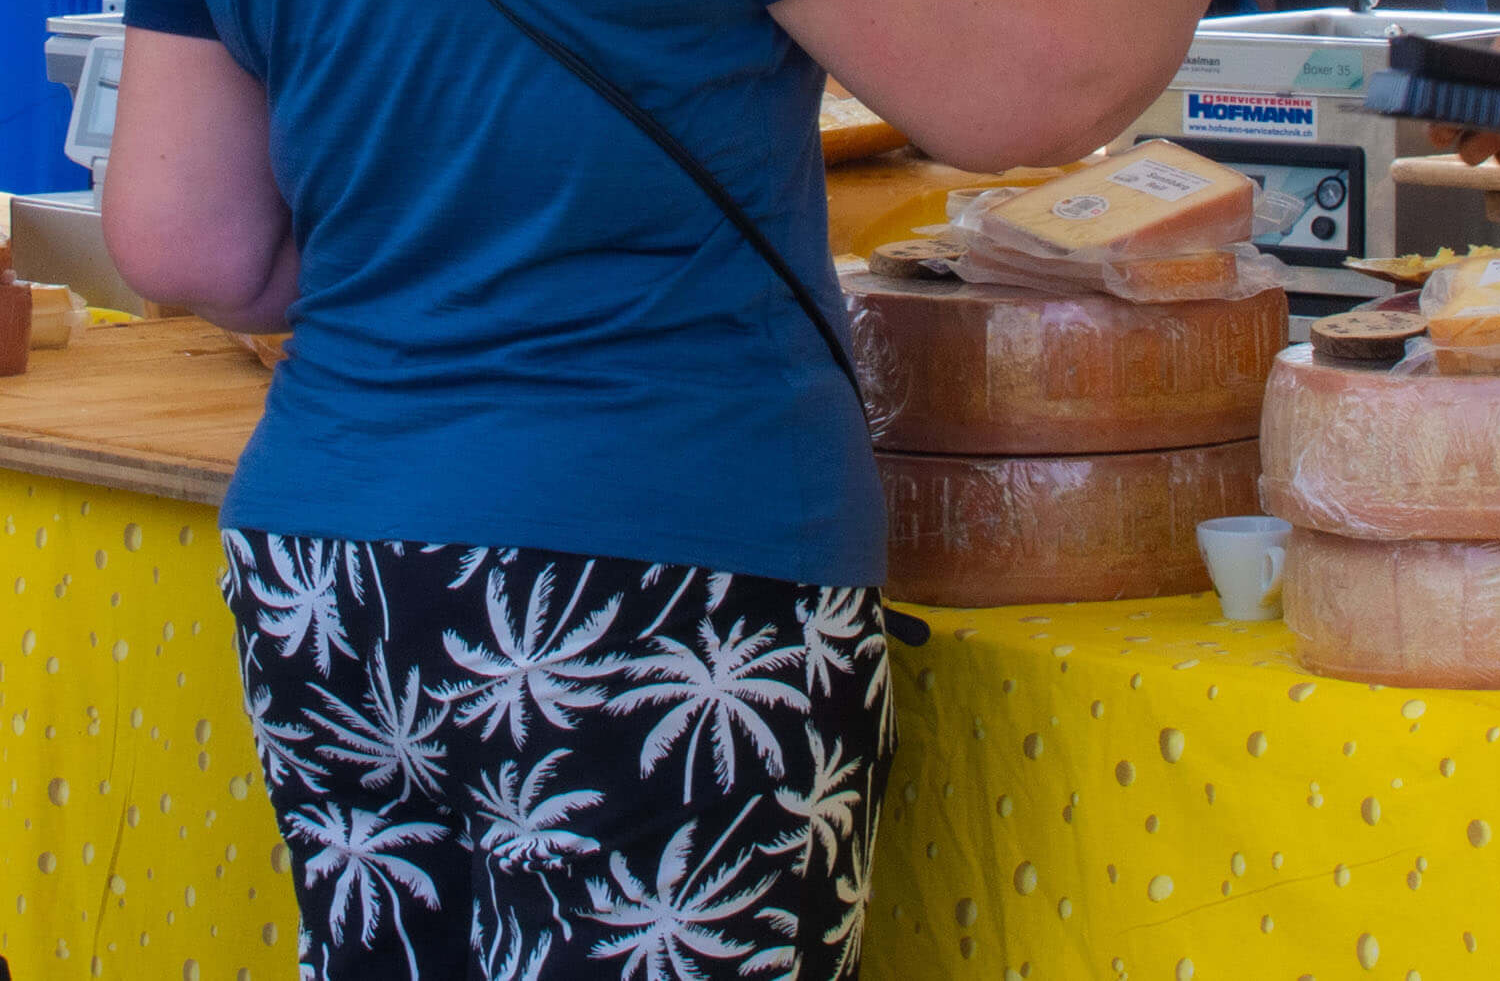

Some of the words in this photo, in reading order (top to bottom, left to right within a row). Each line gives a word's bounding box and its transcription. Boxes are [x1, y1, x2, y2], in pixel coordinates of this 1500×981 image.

[1303, 62, 1332, 75] Boxer
[1337, 64, 1351, 76] 35
[1215, 95, 1312, 107] SERVICETECHNIK
[1188, 93, 1313, 125] HOFMANN
[1188, 124, 1313, 137] www.hofmann-servicetechnik.ch
